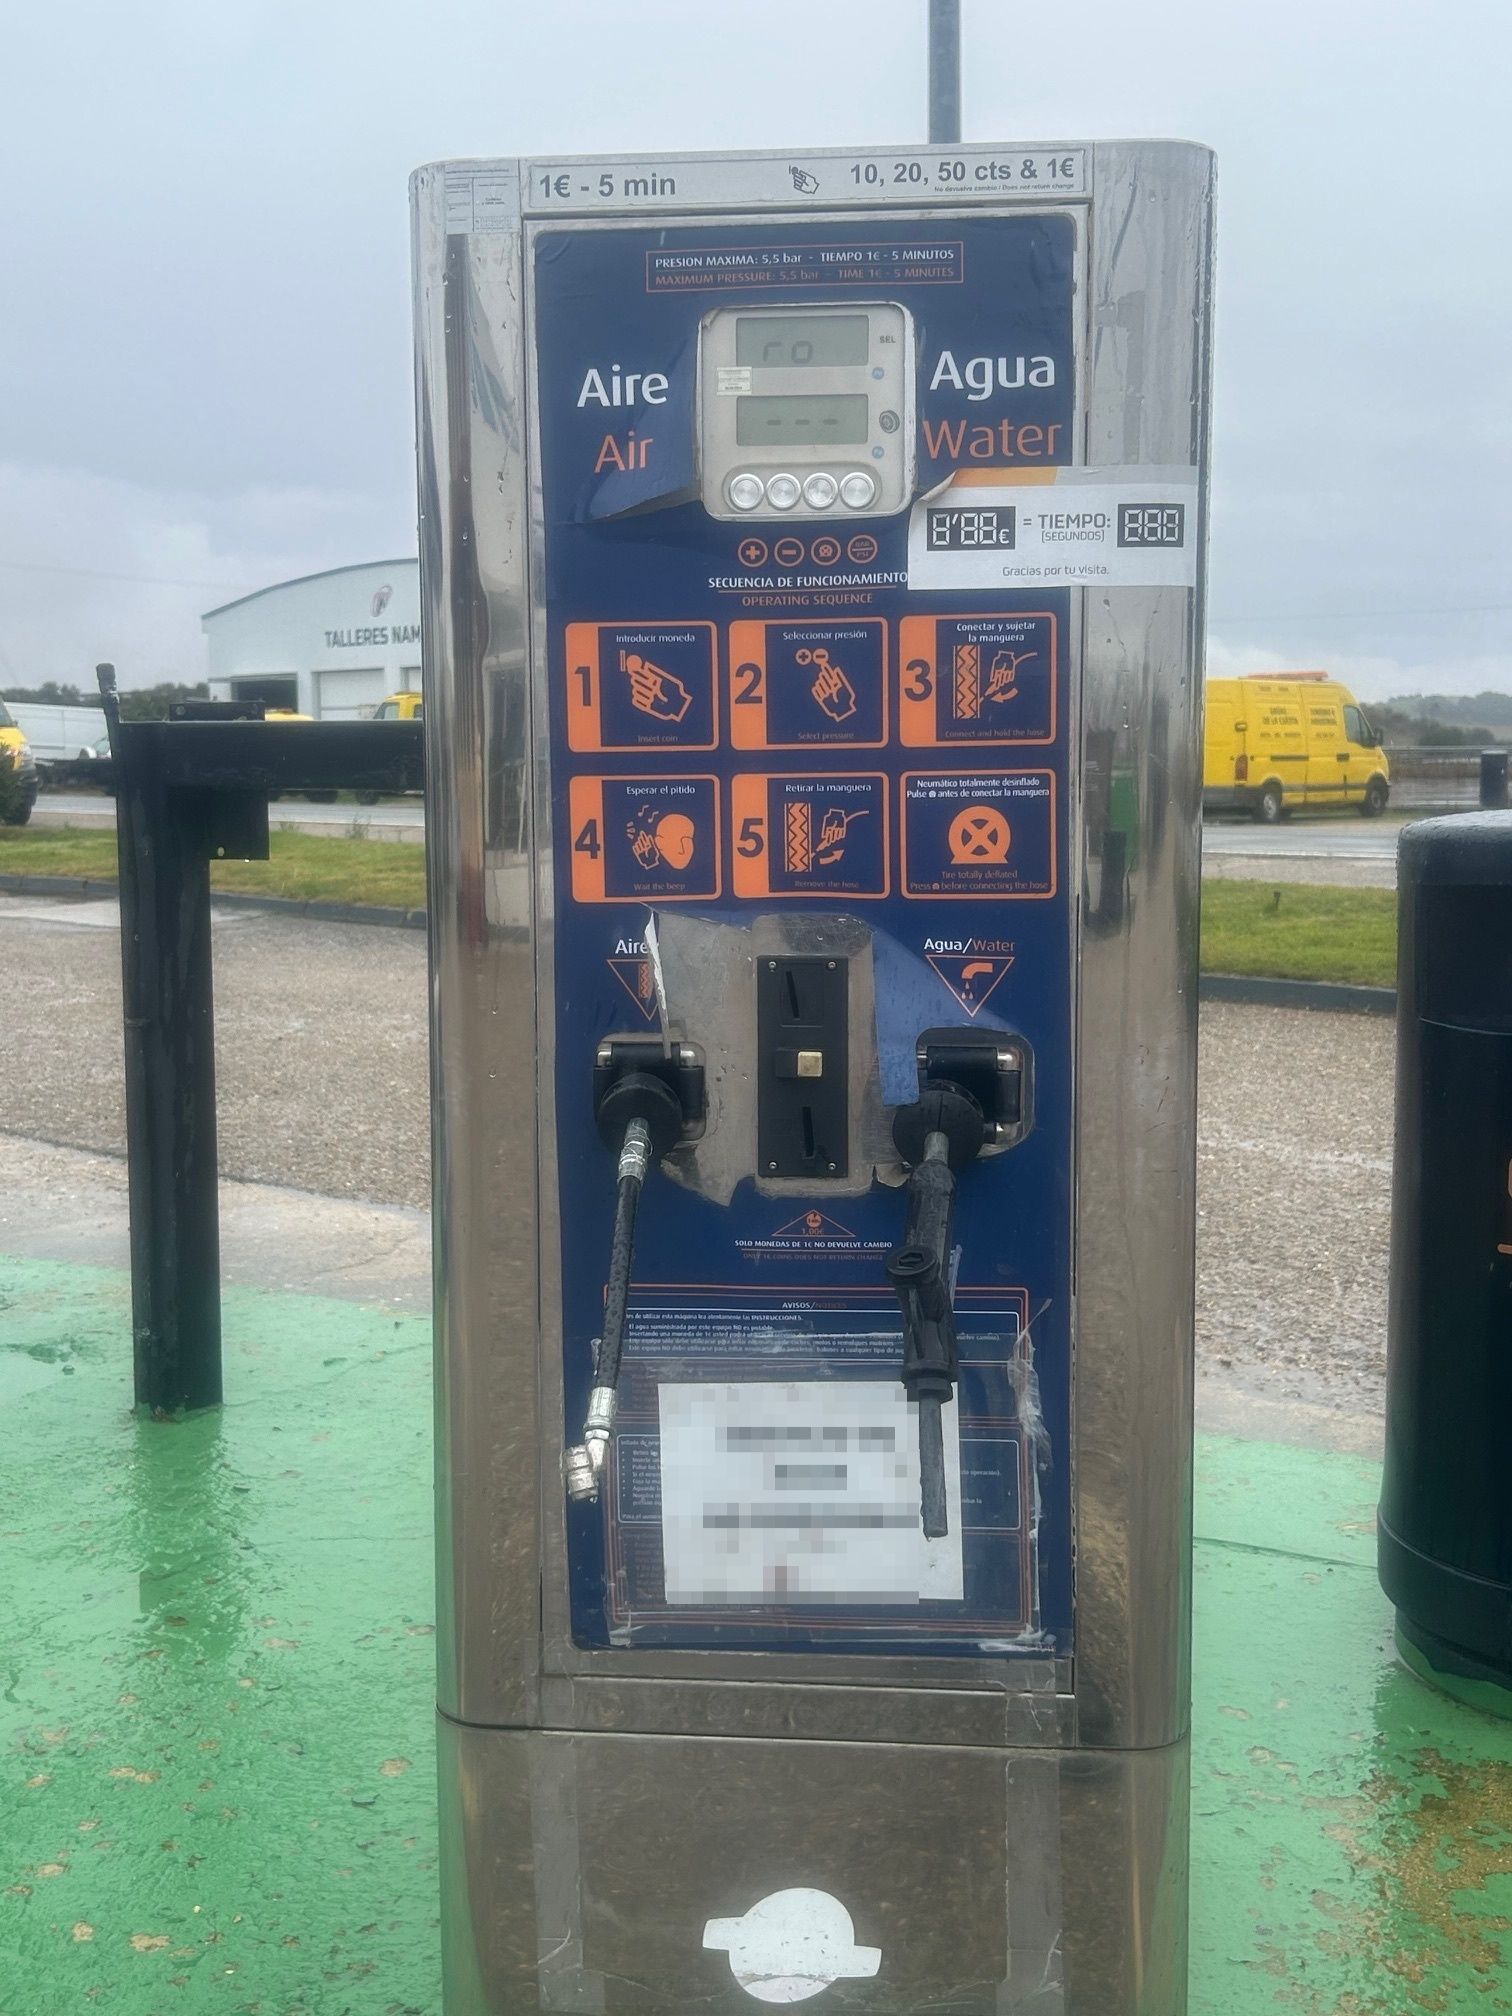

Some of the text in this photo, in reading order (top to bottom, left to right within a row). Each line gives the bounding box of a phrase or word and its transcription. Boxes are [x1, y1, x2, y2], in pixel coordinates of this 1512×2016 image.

[850, 157, 1074, 187] 10, 20, 50 cts & 1€
[539, 174, 571, 198] 1€
[599, 174, 615, 197] 5
[624, 173, 676, 196] min
[655, 256, 703, 269] PRESION
[706, 255, 758, 267] MAXIMA:
[761, 253, 780, 265] 5,5
[783, 252, 802, 264] bar
[820, 251, 863, 263] TIEMPO
[866, 250, 880, 261] 1€
[891, 250, 899, 261] 5
[902, 249, 954, 261] MINUTOS
[655, 273, 714, 286] MAXIMUM
[717, 271, 776, 284] PRESSURE:
[779, 269, 797, 281] 5,5
[801, 269, 820, 280] bar
[837, 268, 864, 279] TIME
[894, 268, 901, 278] 5
[904, 267, 954, 278] MINUTES
[879, 335, 897, 343] SEL
[929, 350, 1055, 401] Agua
[577, 363, 669, 408] Aire
[922, 419, 1063, 459] Water
[594, 431, 655, 473] Air
[1037, 513, 1112, 530] TIEMPO:
[1041, 530, 1105, 544] (SEGUNDOS)
[708, 571, 908, 588] SECUENCIA DE FUNCIONAMIENTO
[1002, 564, 1110, 578] Gracias por tu visita.
[742, 593, 873, 606] OPERATING SEQUENCE
[783, 629, 867, 641] Seleccionar presión
[956, 621, 1036, 632] Conectar y sujetar
[325, 626, 389, 648] TALLERES
[616, 632, 695, 643] Introducir moneda
[968, 633, 1025, 643] la manguera
[574, 666, 591, 707] 1
[734, 662, 763, 705] 2
[904, 659, 932, 702] 3
[626, 785, 696, 797] Esperar el pitido
[785, 783, 872, 794] Retirar la manguera
[917, 777, 1040, 788] Neumático totalmente desinflado
[906, 788, 1050, 798] Pulse antes de conectar la manguera
[575, 819, 601, 860] 4
[736, 818, 764, 858] 5
[615, 938, 648, 954] Aire
[754, 1240, 790, 1248] MONEDAS
